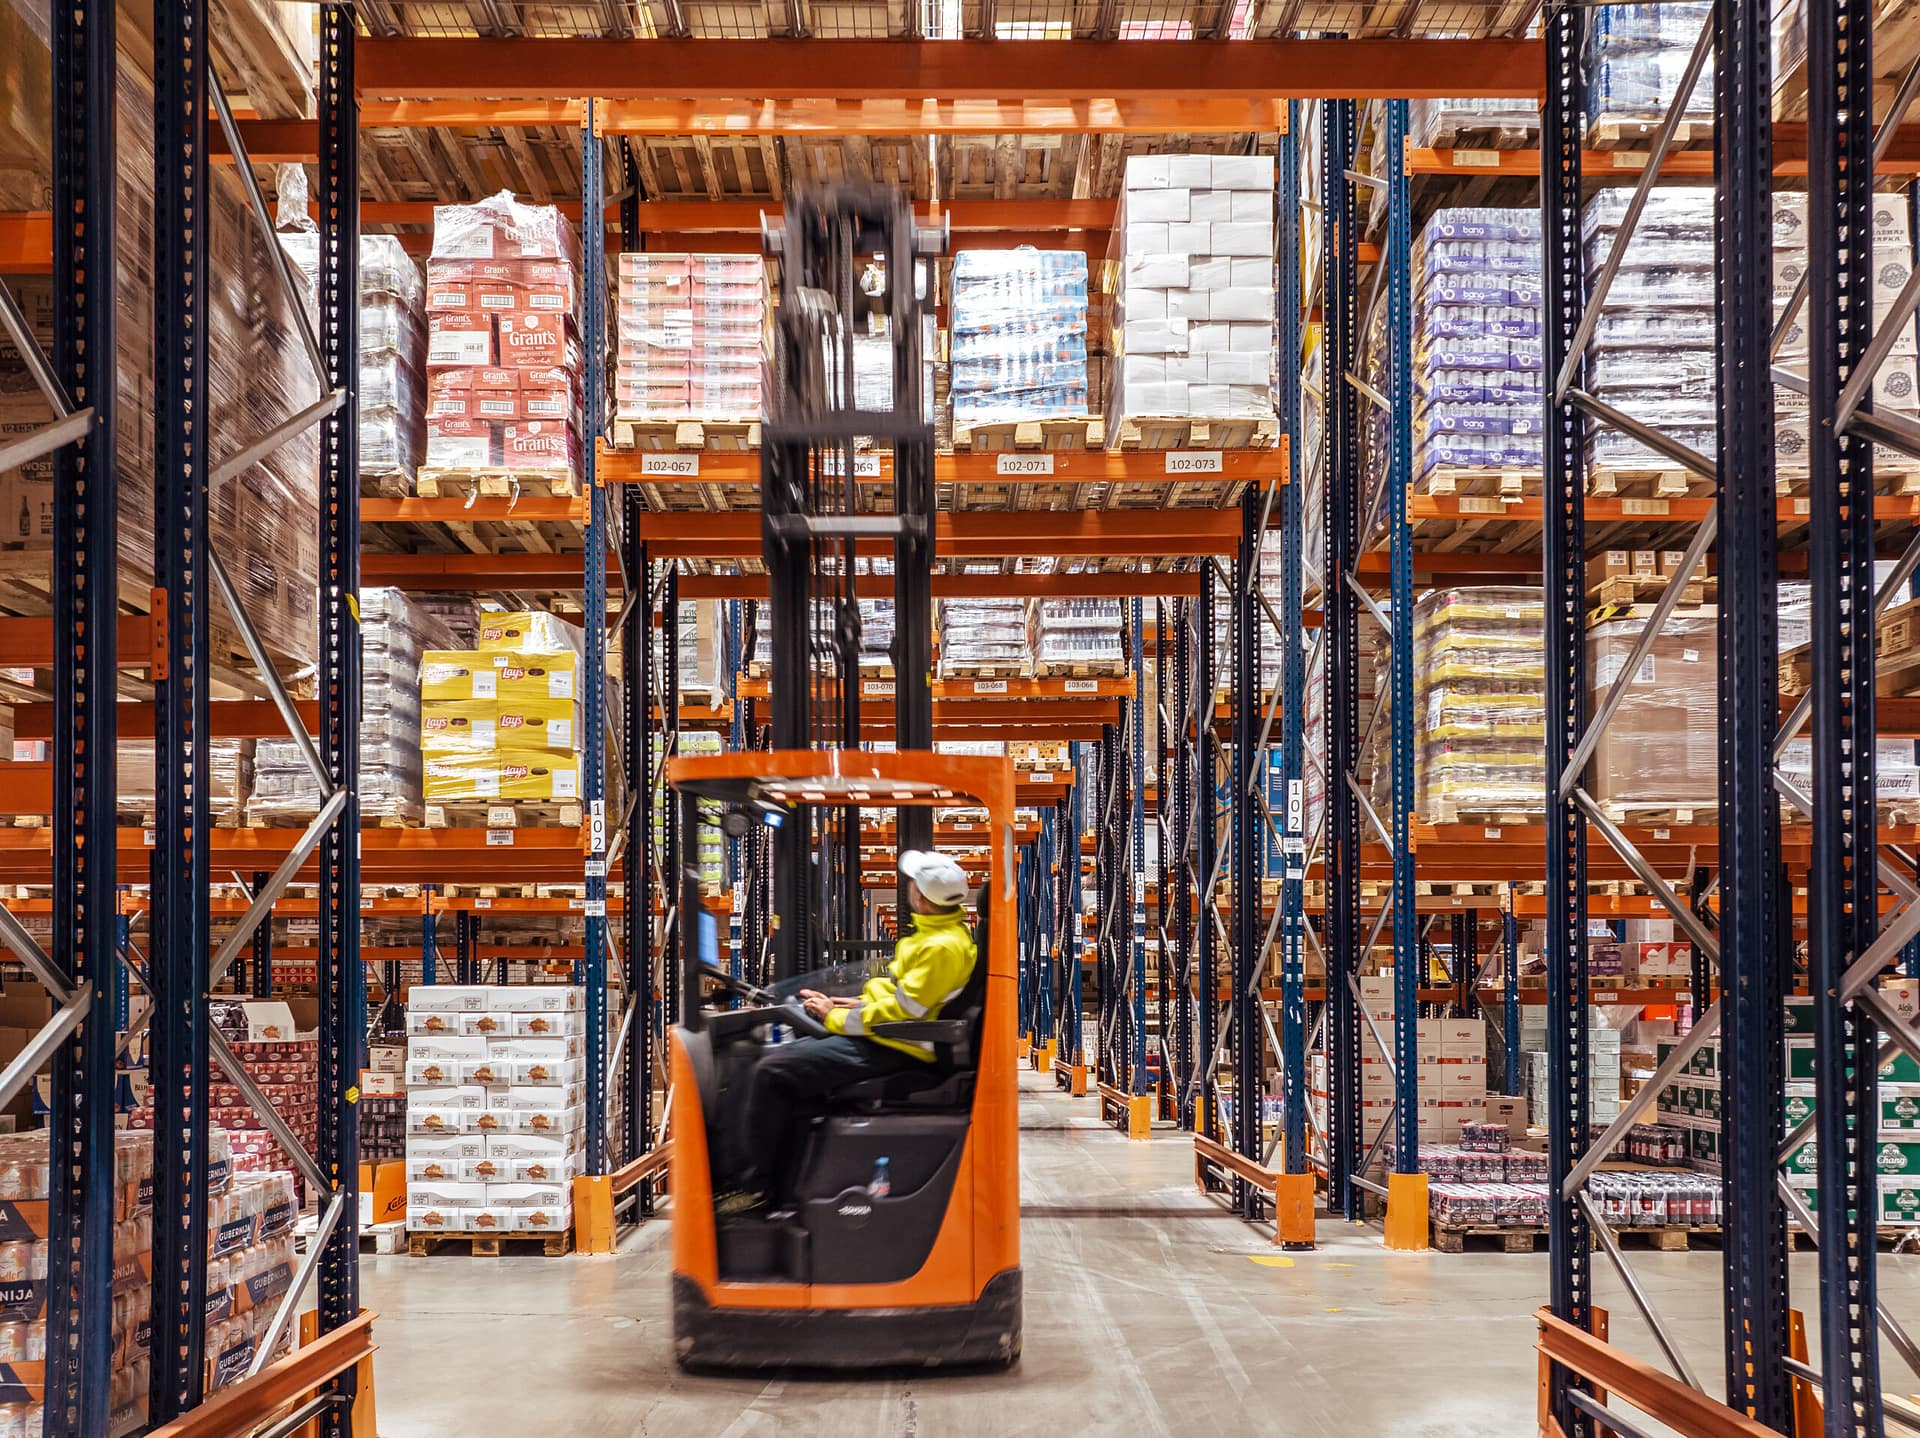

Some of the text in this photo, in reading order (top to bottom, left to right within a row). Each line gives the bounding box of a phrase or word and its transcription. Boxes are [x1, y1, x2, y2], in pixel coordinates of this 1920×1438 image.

[1463, 226, 1484, 235] bang
[484, 266, 509, 274] Grant's
[1463, 290, 1484, 300] bang
[445, 314, 472, 322] Grant's
[509, 331, 556, 346] Grant's
[483, 371, 510, 380] Grant's
[444, 420, 471, 429] Grant's
[1463, 420, 1484, 429] bang
[513, 437, 559, 452] Grant's
[648, 461, 692, 472] 102-067
[1003, 461, 1046, 472] 102-071
[1171, 460, 1216, 470] 102-073
[502, 667, 524, 680] Lay's
[426, 718, 448, 729] Lay's
[501, 715, 523, 728] Lay's
[1876, 774, 1912, 792] eavenly
[1291, 782, 1300, 830] 102
[593, 803, 602, 850] 102
[1798, 1156, 1816, 1164] Cha
[1878, 1156, 1905, 1166] Chang
[138, 1186, 154, 1198] GUB
[219, 1223, 250, 1242] GUBERNIJA
[0, 1288, 34, 1300] NIJA
